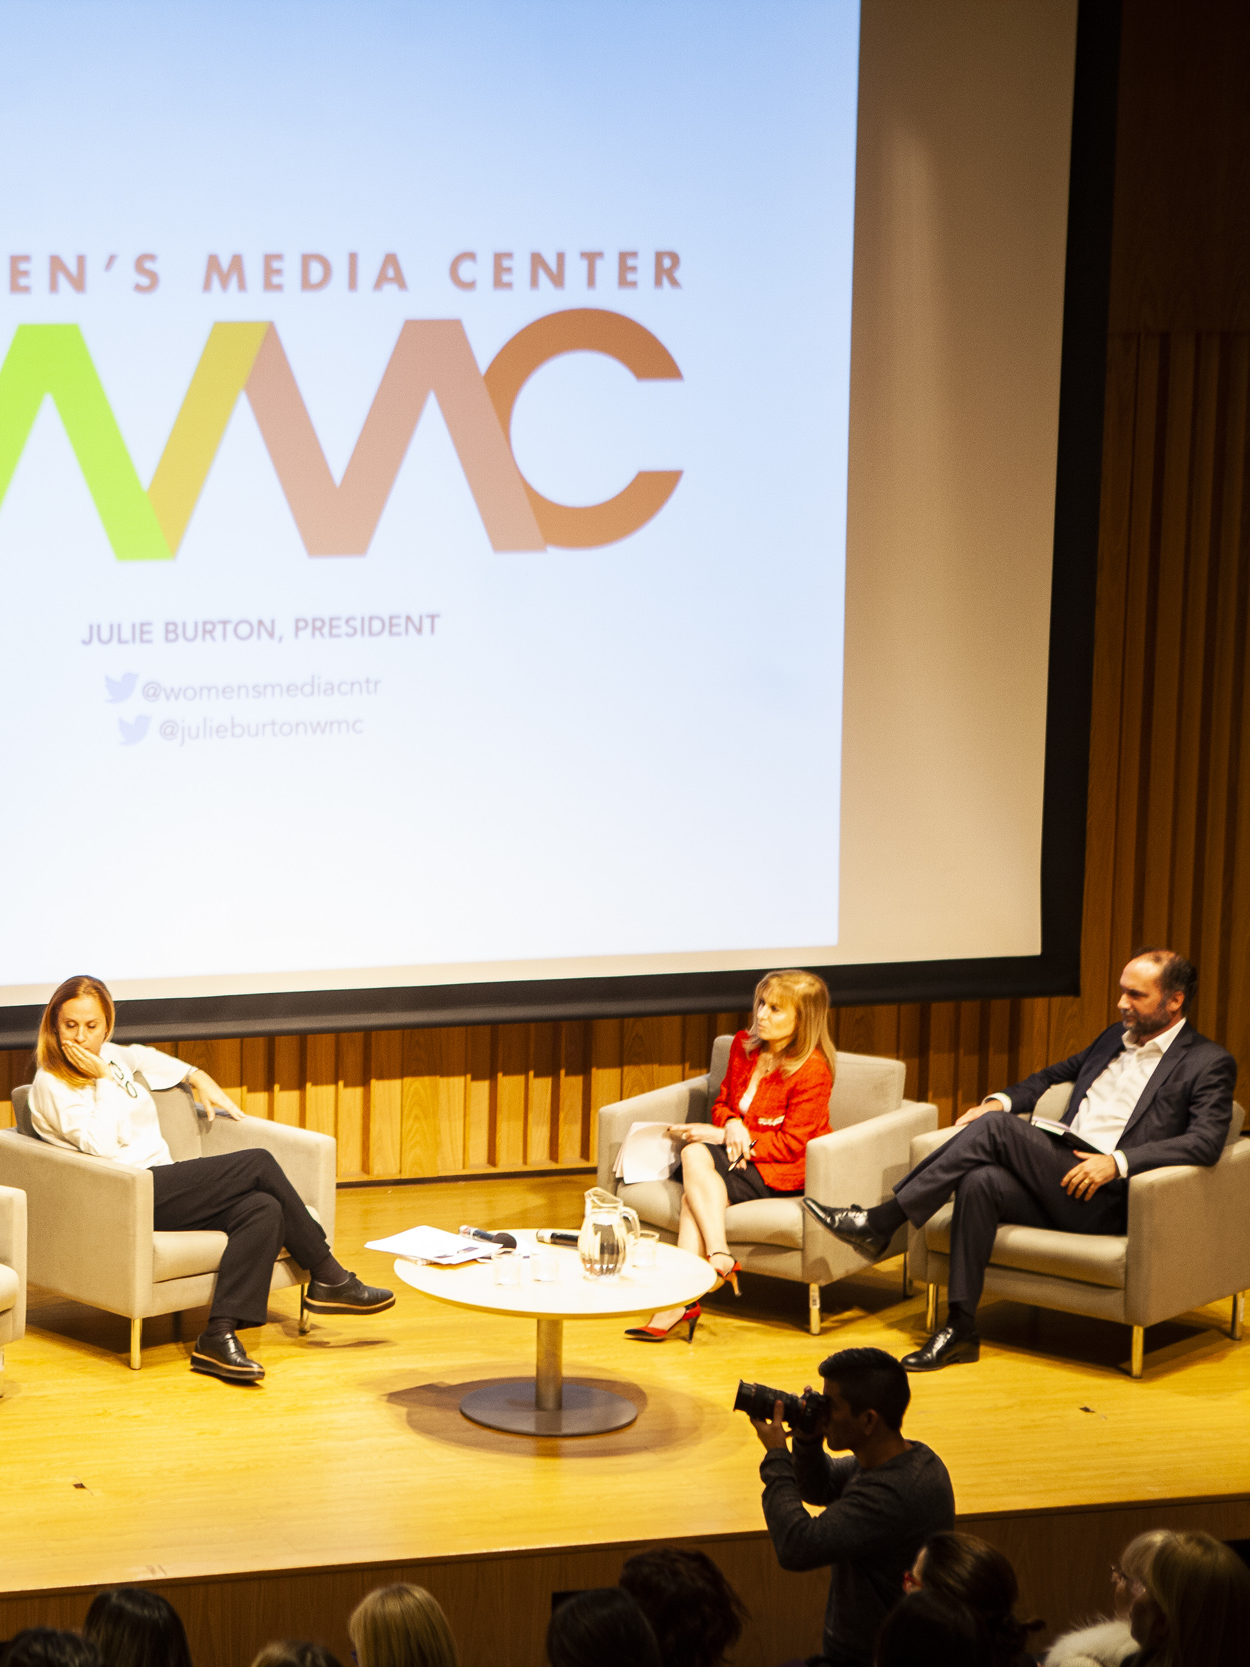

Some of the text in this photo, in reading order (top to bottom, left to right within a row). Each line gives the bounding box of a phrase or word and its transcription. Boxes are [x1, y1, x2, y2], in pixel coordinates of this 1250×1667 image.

[201, 250, 410, 294] MEDIA
[448, 249, 685, 292] CENTER
[81, 613, 441, 646] JULIE BURTON, PRESIDENT
[142, 674, 382, 703] @womensmediacntr
[159, 716, 364, 746] @julieburtonwmc
